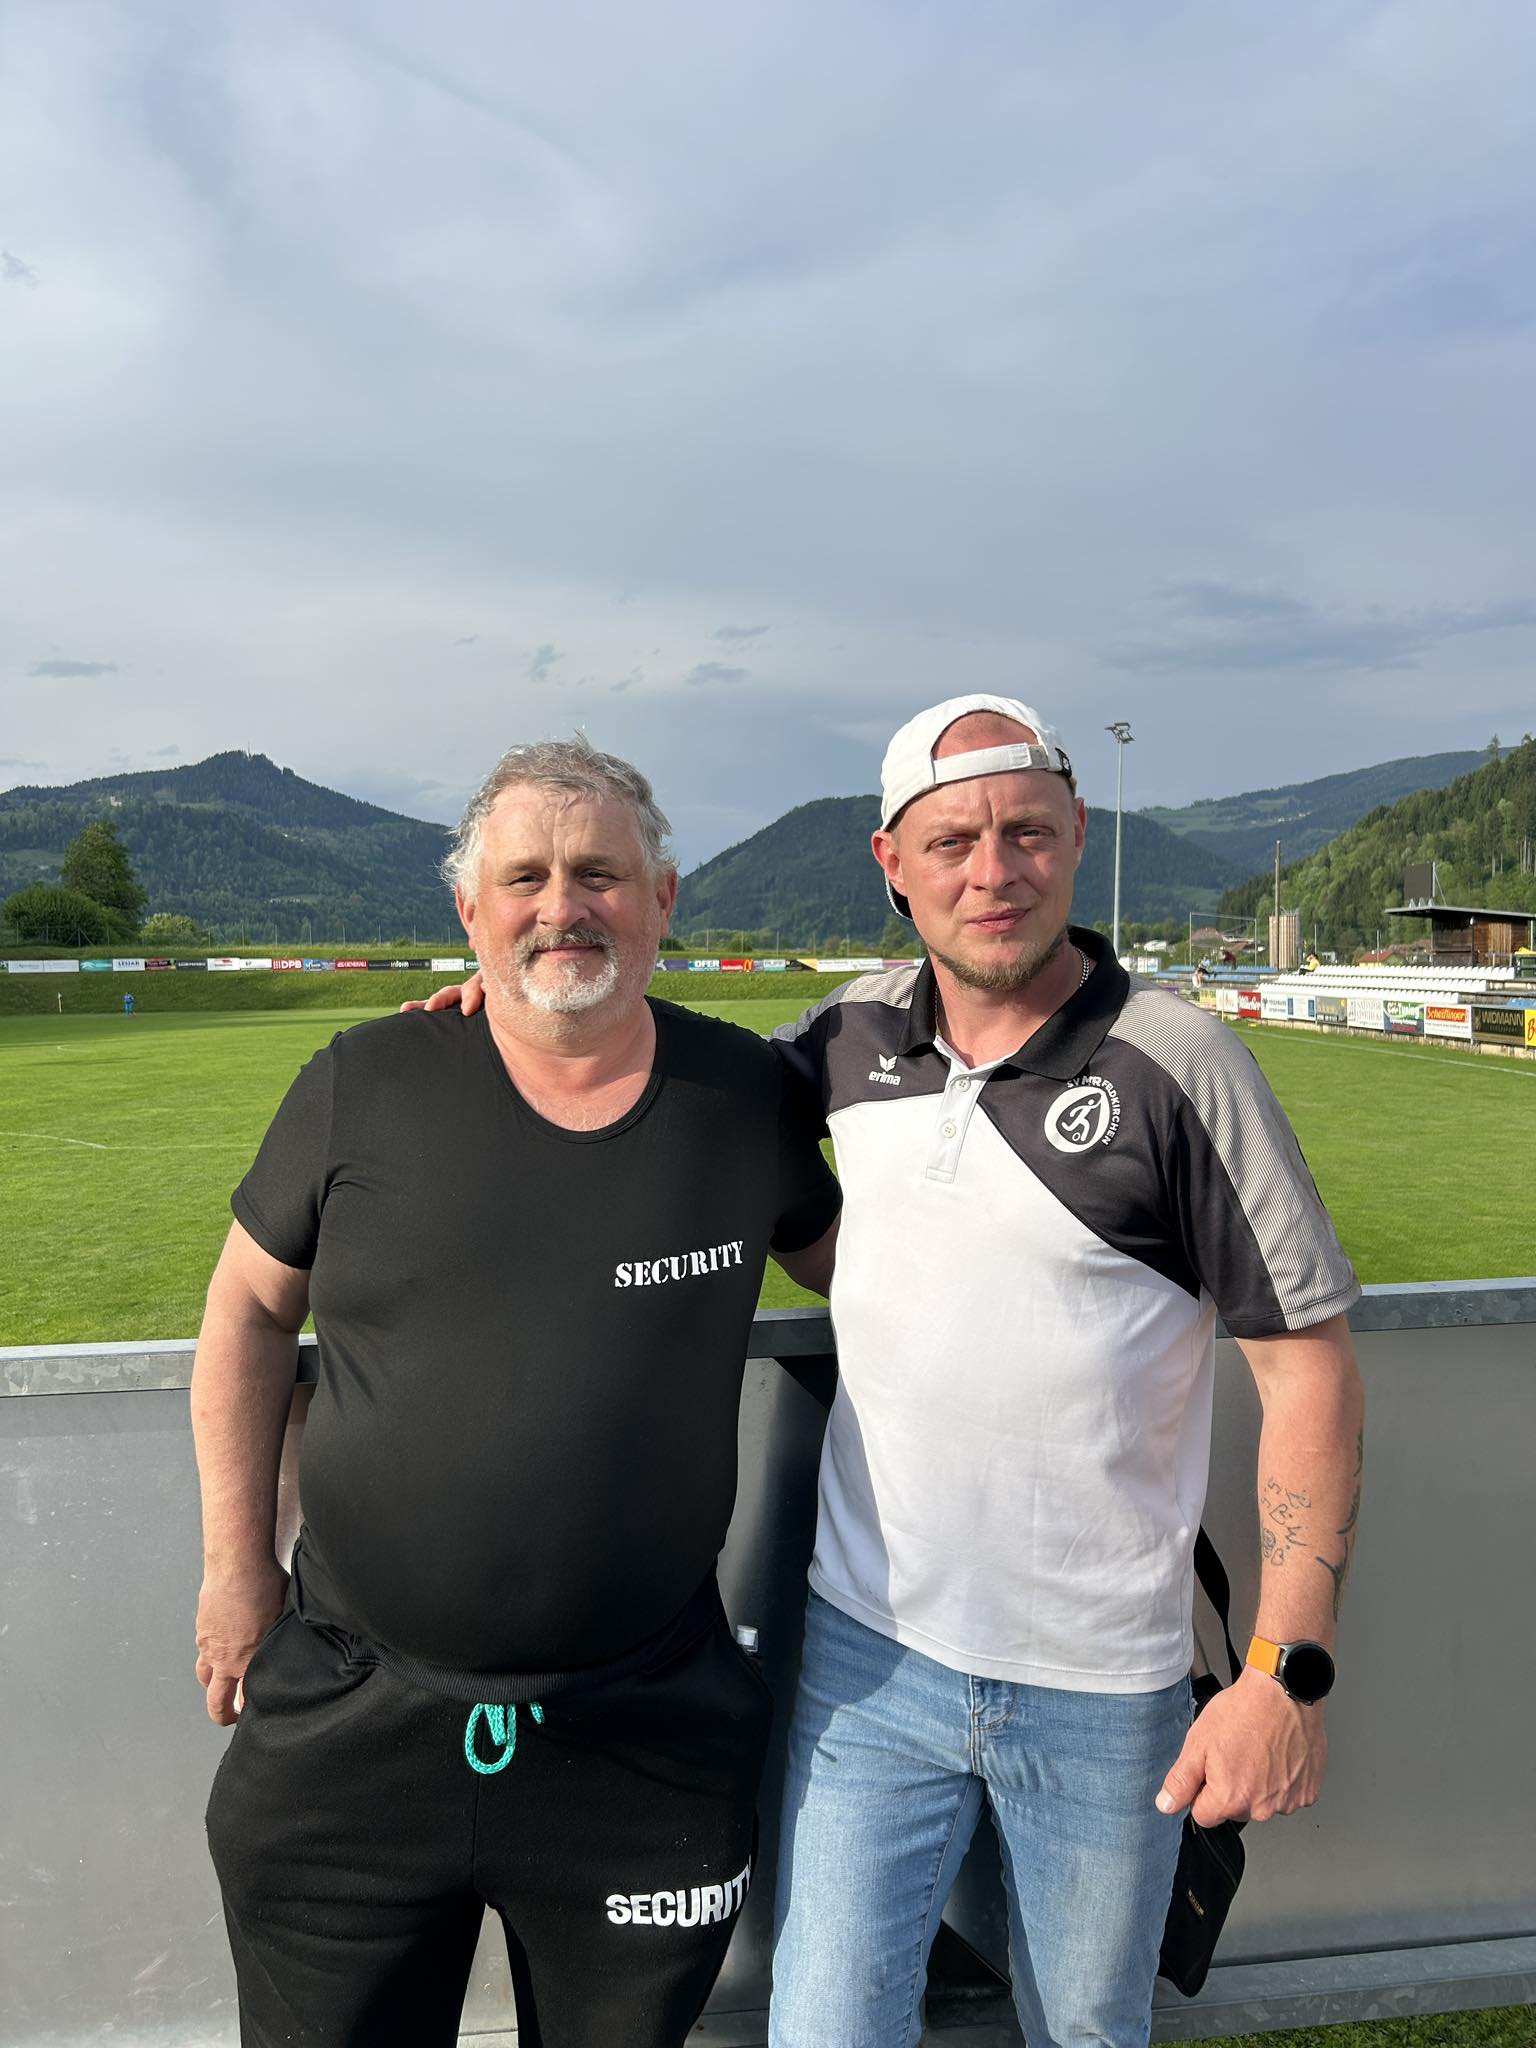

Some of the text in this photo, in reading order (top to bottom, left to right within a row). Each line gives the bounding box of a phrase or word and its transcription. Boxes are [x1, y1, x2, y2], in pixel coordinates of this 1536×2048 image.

[1481, 1010, 1524, 1027] WIDMANN
[868, 1070, 902, 1086] erima
[1101, 1079, 1121, 1146] FELDKIRCHEN
[614, 1240, 744, 1288] SECURITY
